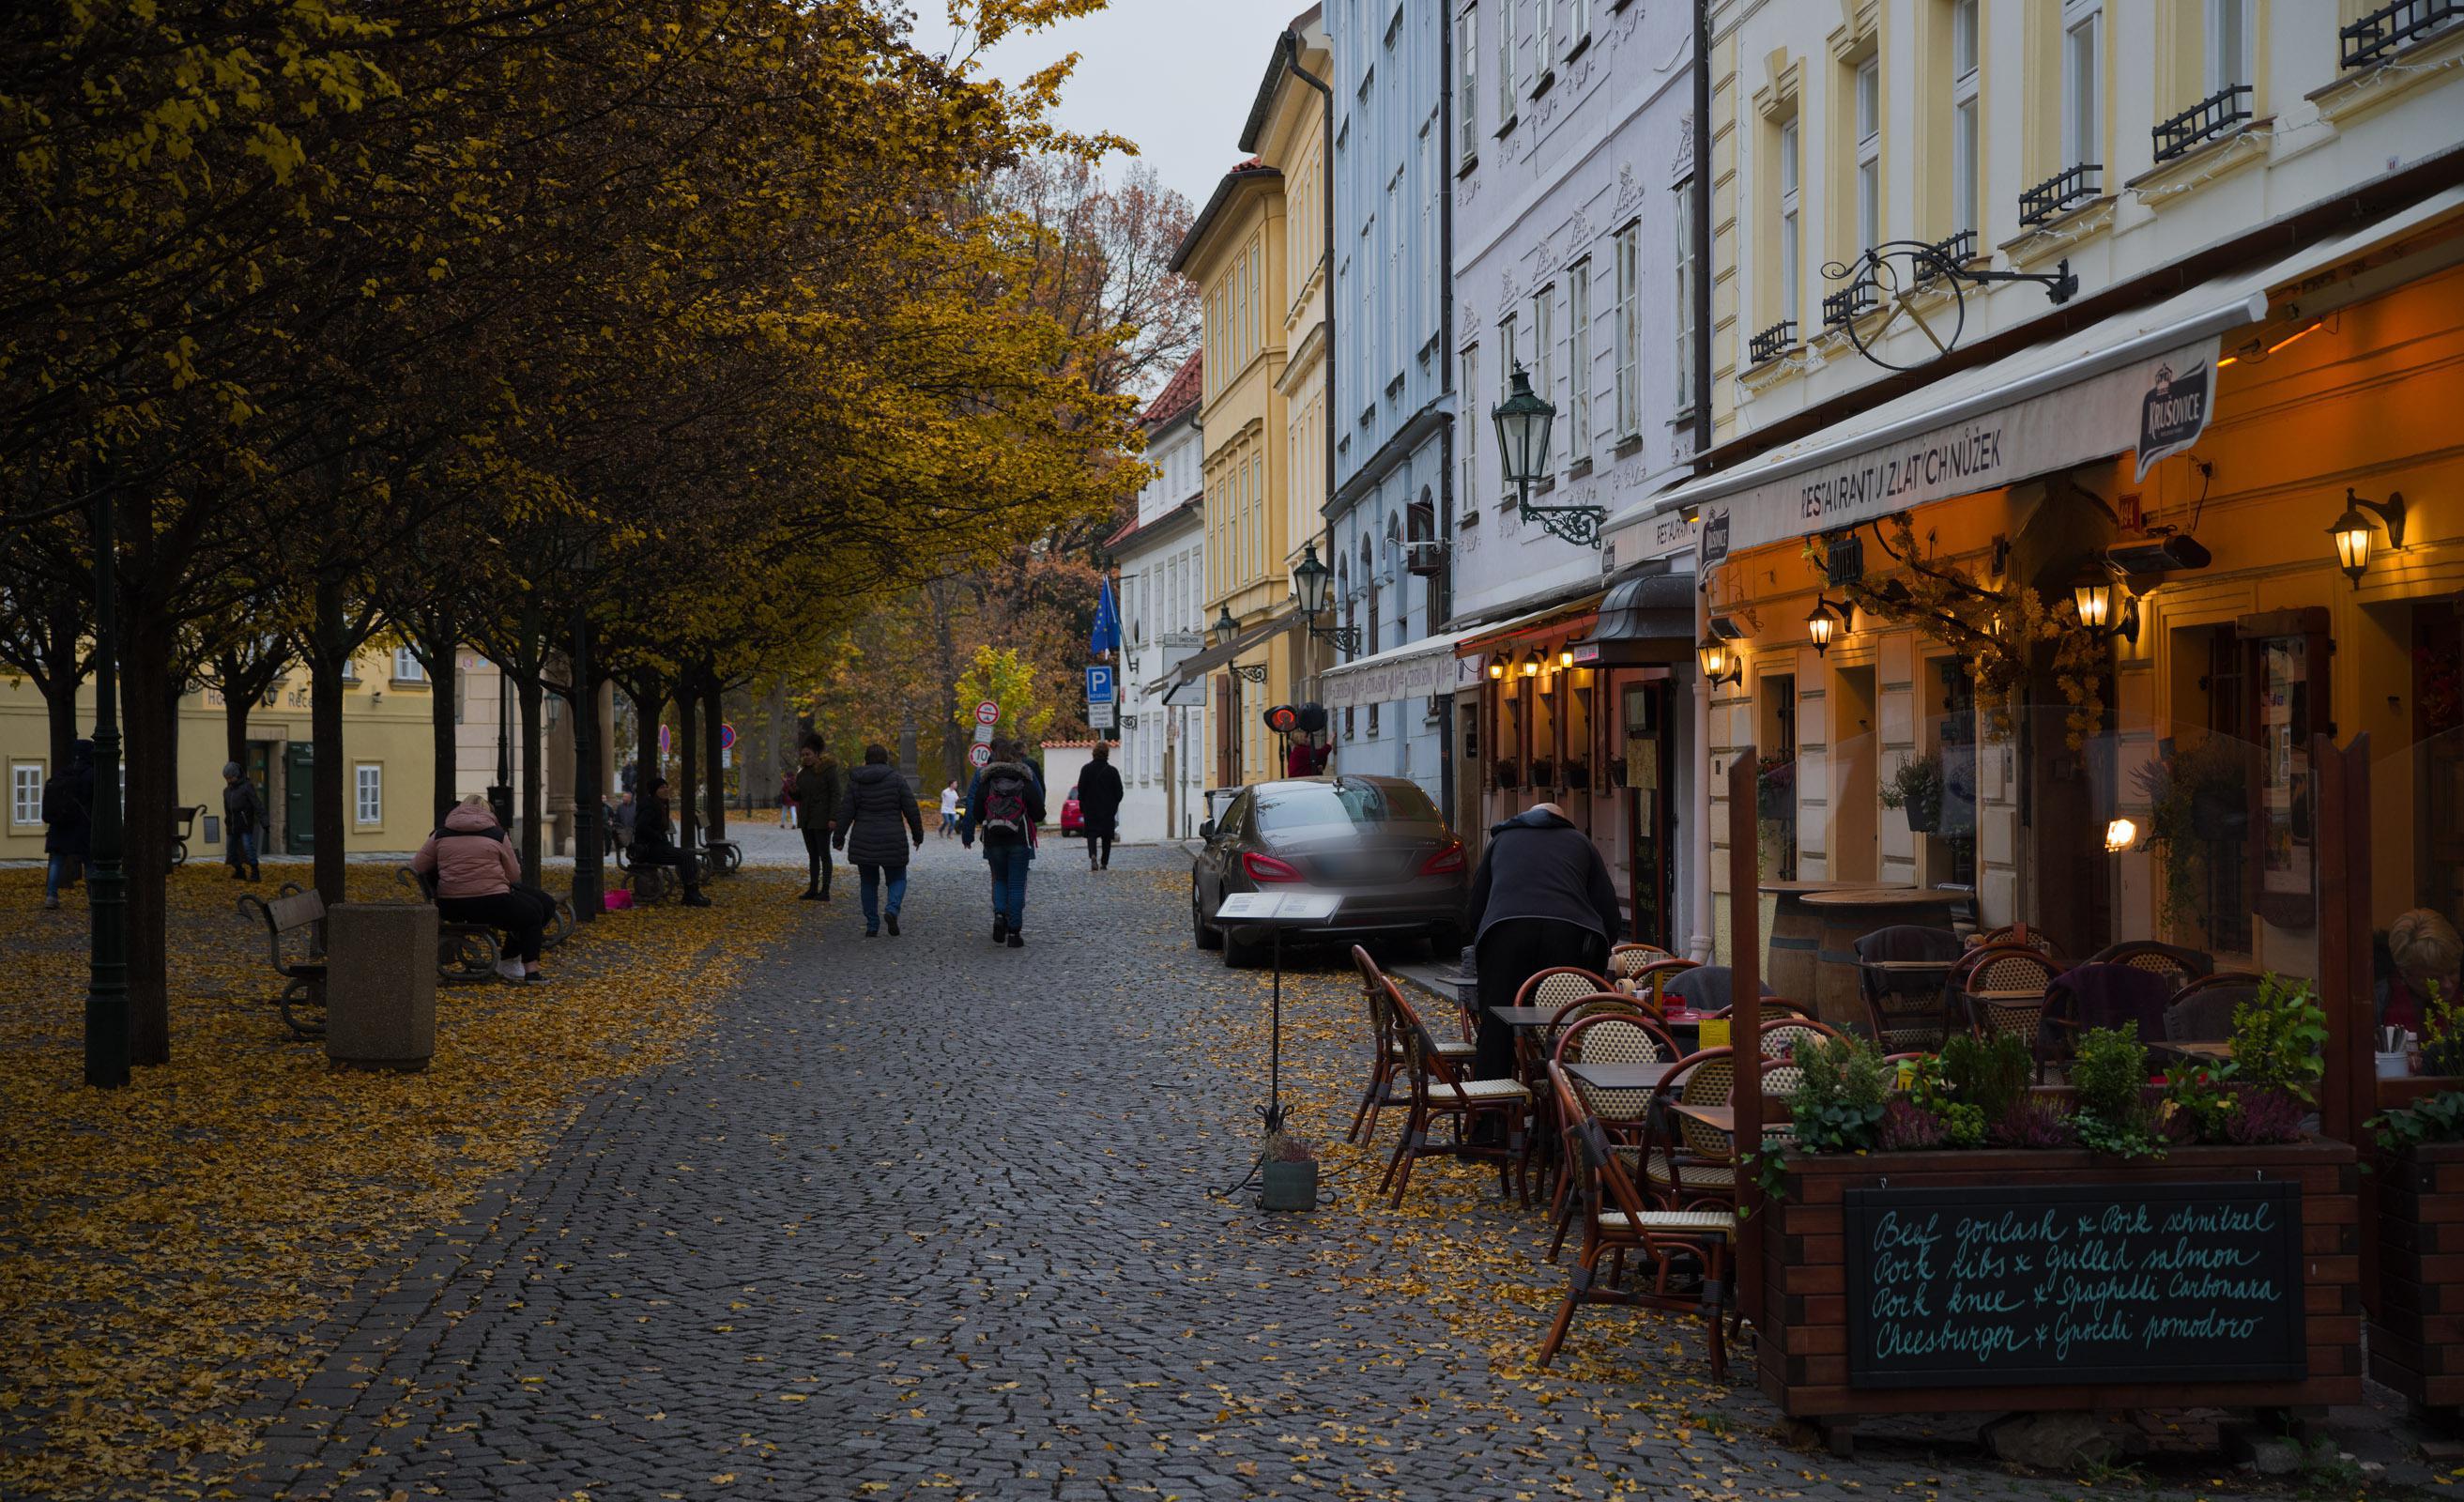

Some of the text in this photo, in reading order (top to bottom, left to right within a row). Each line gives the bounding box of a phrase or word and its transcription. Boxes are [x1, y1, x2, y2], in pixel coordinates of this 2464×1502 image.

[2148, 391, 2201, 440] KRUŠOVICE
[1800, 468, 1875, 520] RESTAURANT
[1875, 465, 1884, 499] U
[1949, 426, 2002, 479] NŮŽEK
[1829, 544, 1858, 581] HOTEL
[1092, 670, 1108, 692] P
[976, 749, 988, 762] 10
[1955, 1208, 2069, 1263] goulash
[2101, 1204, 2153, 1234] Pork
[2160, 1202, 2276, 1235] schnitzel
[1874, 1235, 2261, 1293] Pork ribs Grilled salmon
[1872, 1282, 1931, 1319] Pork
[1945, 1281, 2026, 1314] knee
[2056, 1273, 2160, 1322] Spaghetti
[1876, 1308, 2264, 1362] Cheesburger Gnocchi pomodoro
